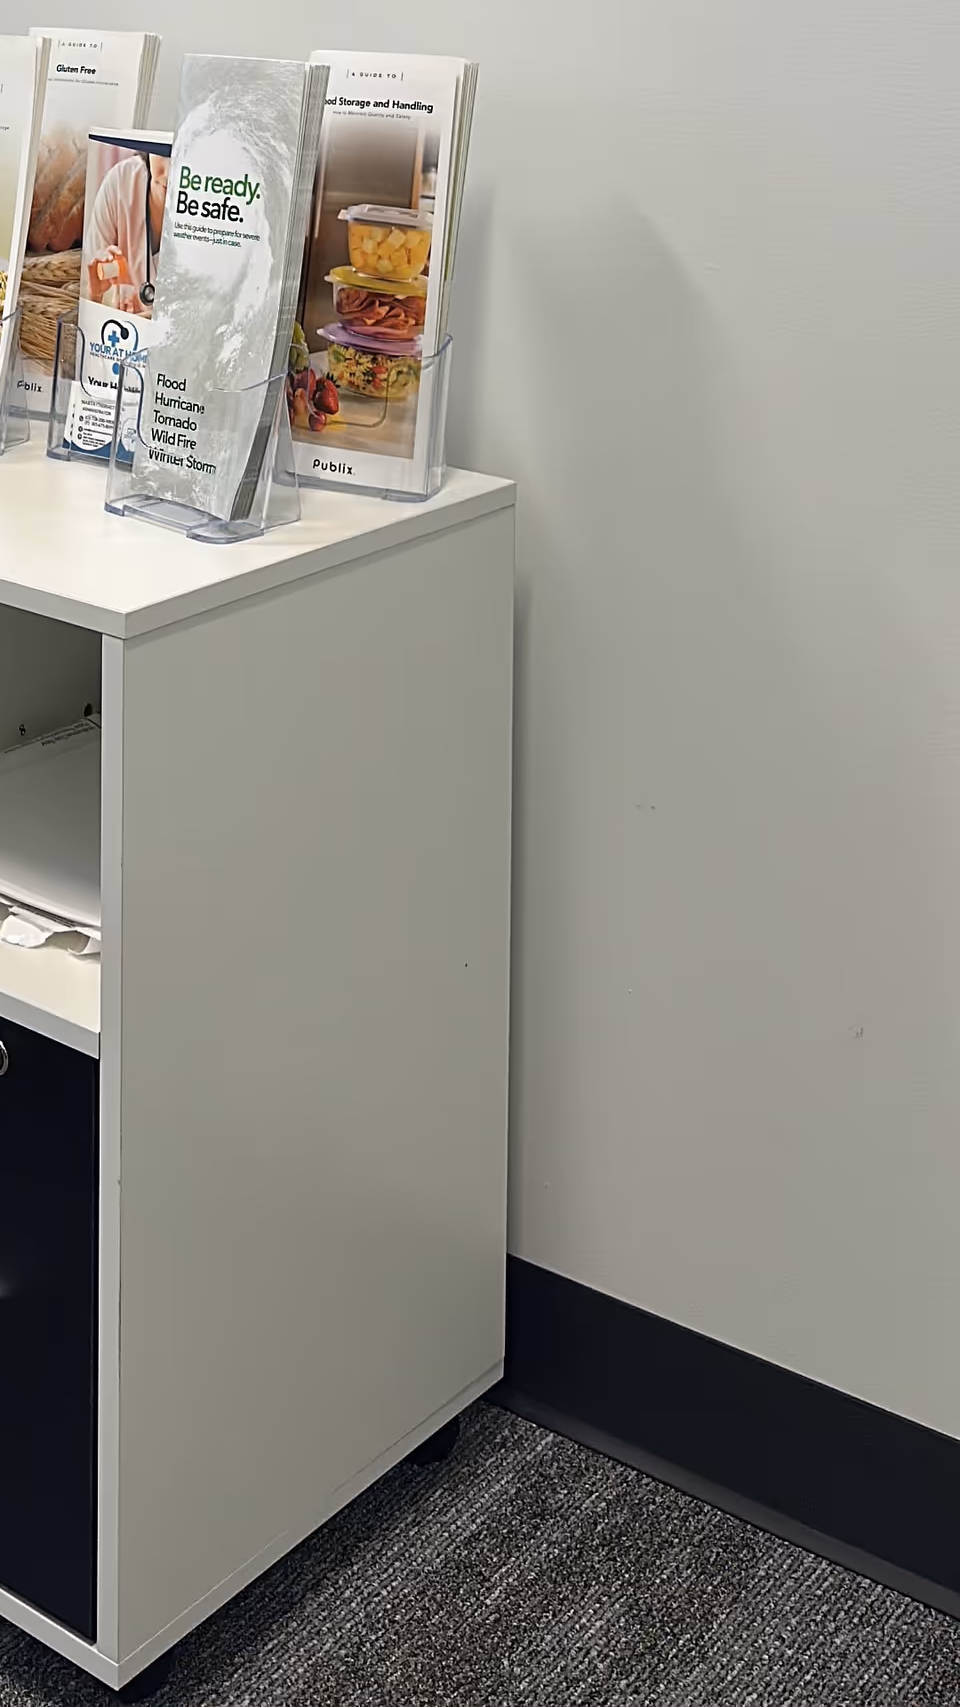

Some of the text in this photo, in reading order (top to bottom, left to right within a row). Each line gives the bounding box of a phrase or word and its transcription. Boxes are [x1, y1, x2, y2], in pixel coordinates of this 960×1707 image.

[57, 64, 96, 74] Gluten Free
[325, 96, 434, 113] ood Storage and Handling
[179, 166, 260, 205] Be ready.
[176, 191, 243, 223] Be safe.
[193, 225, 206, 233] guide
[213, 229, 234, 238] prepare
[243, 233, 260, 241] severe
[90, 342, 124, 357] YOUR AT
[88, 376, 108, 387] Your
[157, 373, 186, 391] Flood
[155, 392, 205, 414] Hurricane
[153, 410, 197, 431] Tornado
[151, 428, 196, 449] Wild Fire
[148, 446, 216, 474] Winter Storm
[313, 459, 353, 475] Publix
